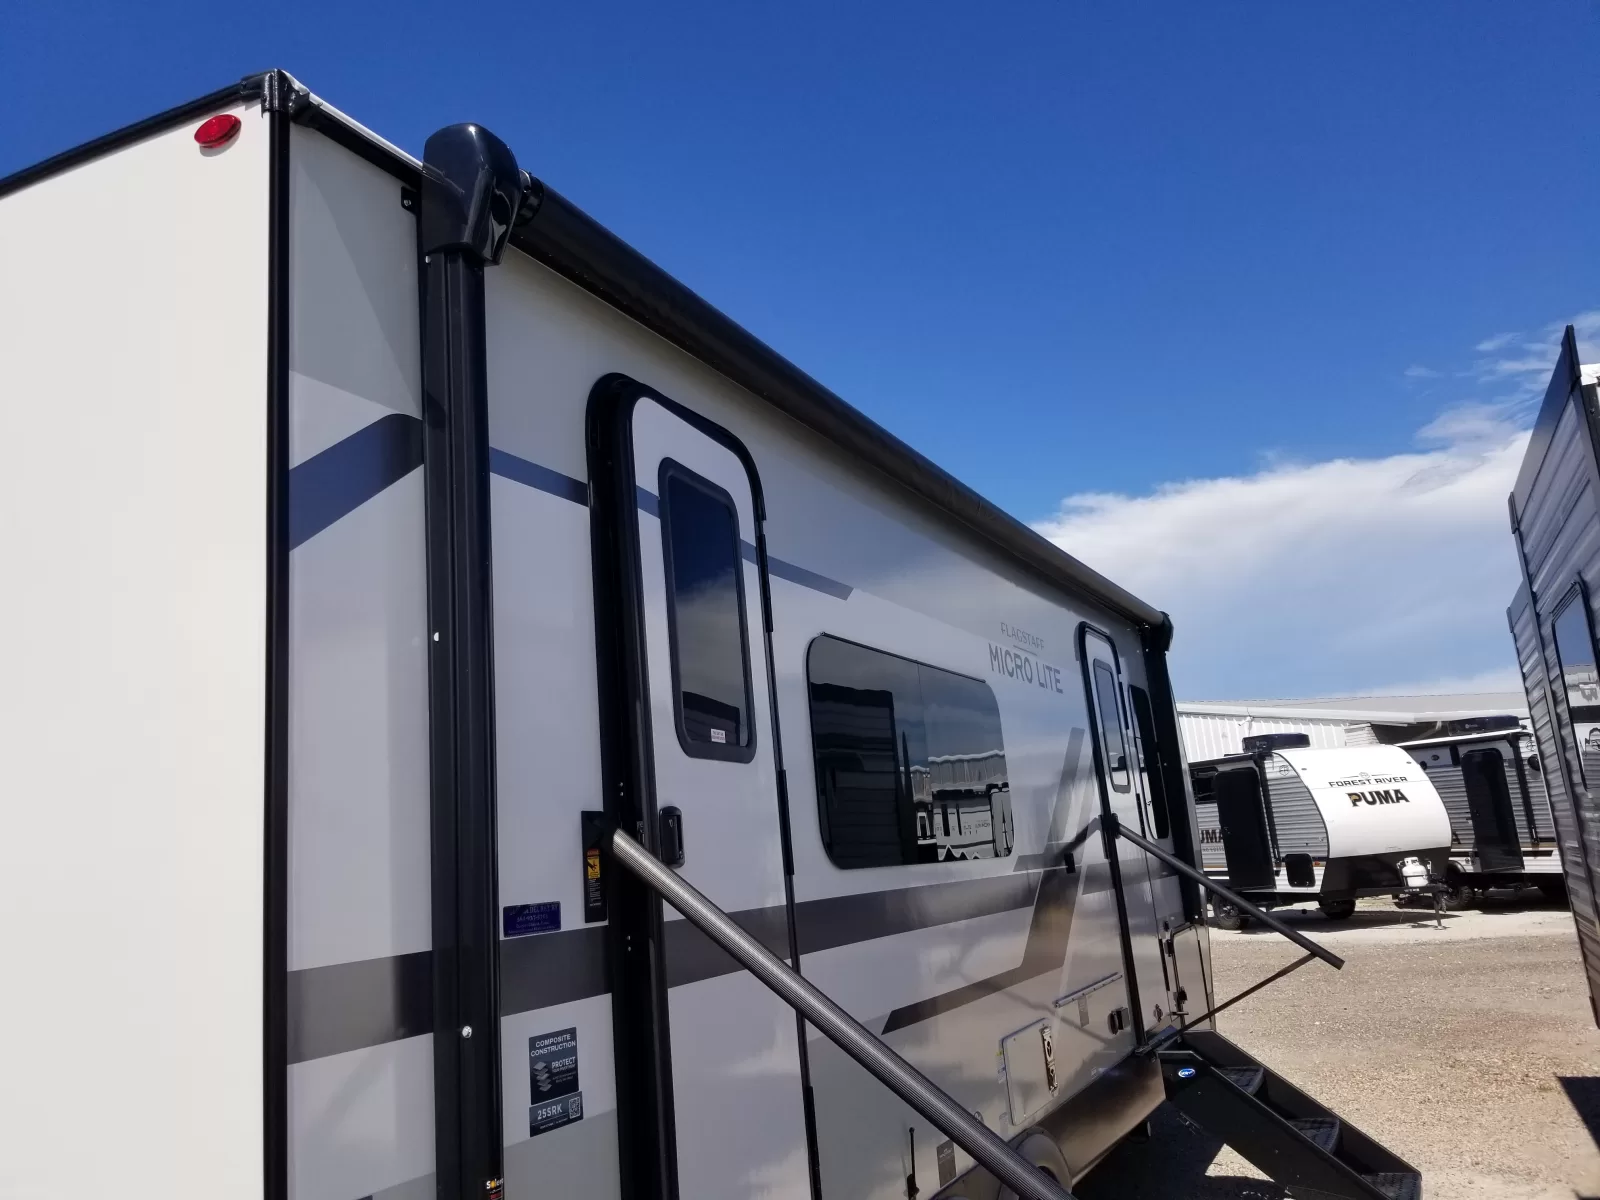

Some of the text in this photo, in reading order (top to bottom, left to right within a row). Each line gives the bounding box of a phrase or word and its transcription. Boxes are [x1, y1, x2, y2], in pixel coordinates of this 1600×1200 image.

[1000, 621, 1044, 650] FLAGSTAFF
[988, 642, 1063, 694] MICRO LITE
[1328, 776, 1408, 787] FOREST RIVER
[1345, 789, 1410, 807] PUMA
[530, 1040, 576, 1057] CONSTRUCTION
[535, 1034, 571, 1047] COMPOSITE
[551, 1056, 576, 1069] PROTECT
[537, 1103, 562, 1120] 25SRK
